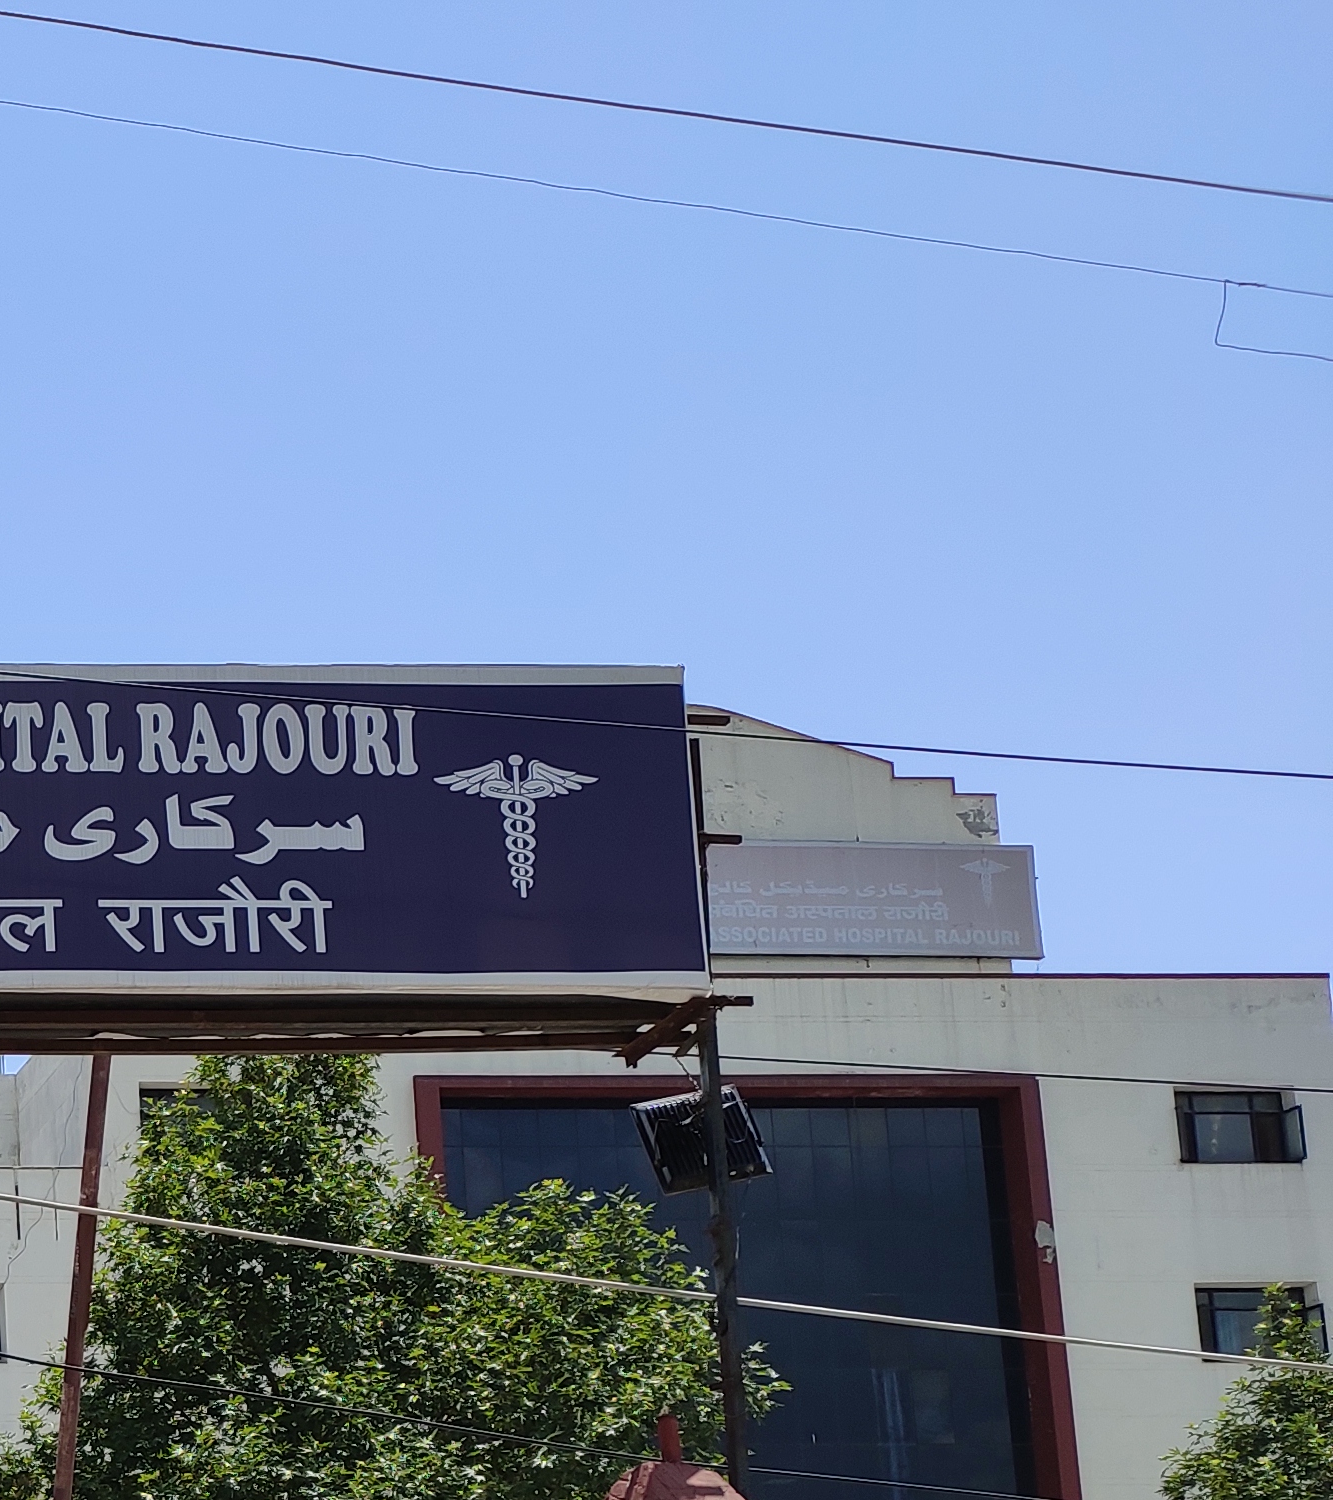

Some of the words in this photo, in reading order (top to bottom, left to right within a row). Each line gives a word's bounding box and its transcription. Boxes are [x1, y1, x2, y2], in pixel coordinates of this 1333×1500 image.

[136, 702, 419, 776] RAJOURI
[44, 793, 365, 865] سرکاری
[97, 875, 333, 953] राजौरी
[784, 905, 878, 921] अस्पताल
[834, 927, 928, 944] HOSPITAL
[935, 928, 1020, 945] RAJOURI
